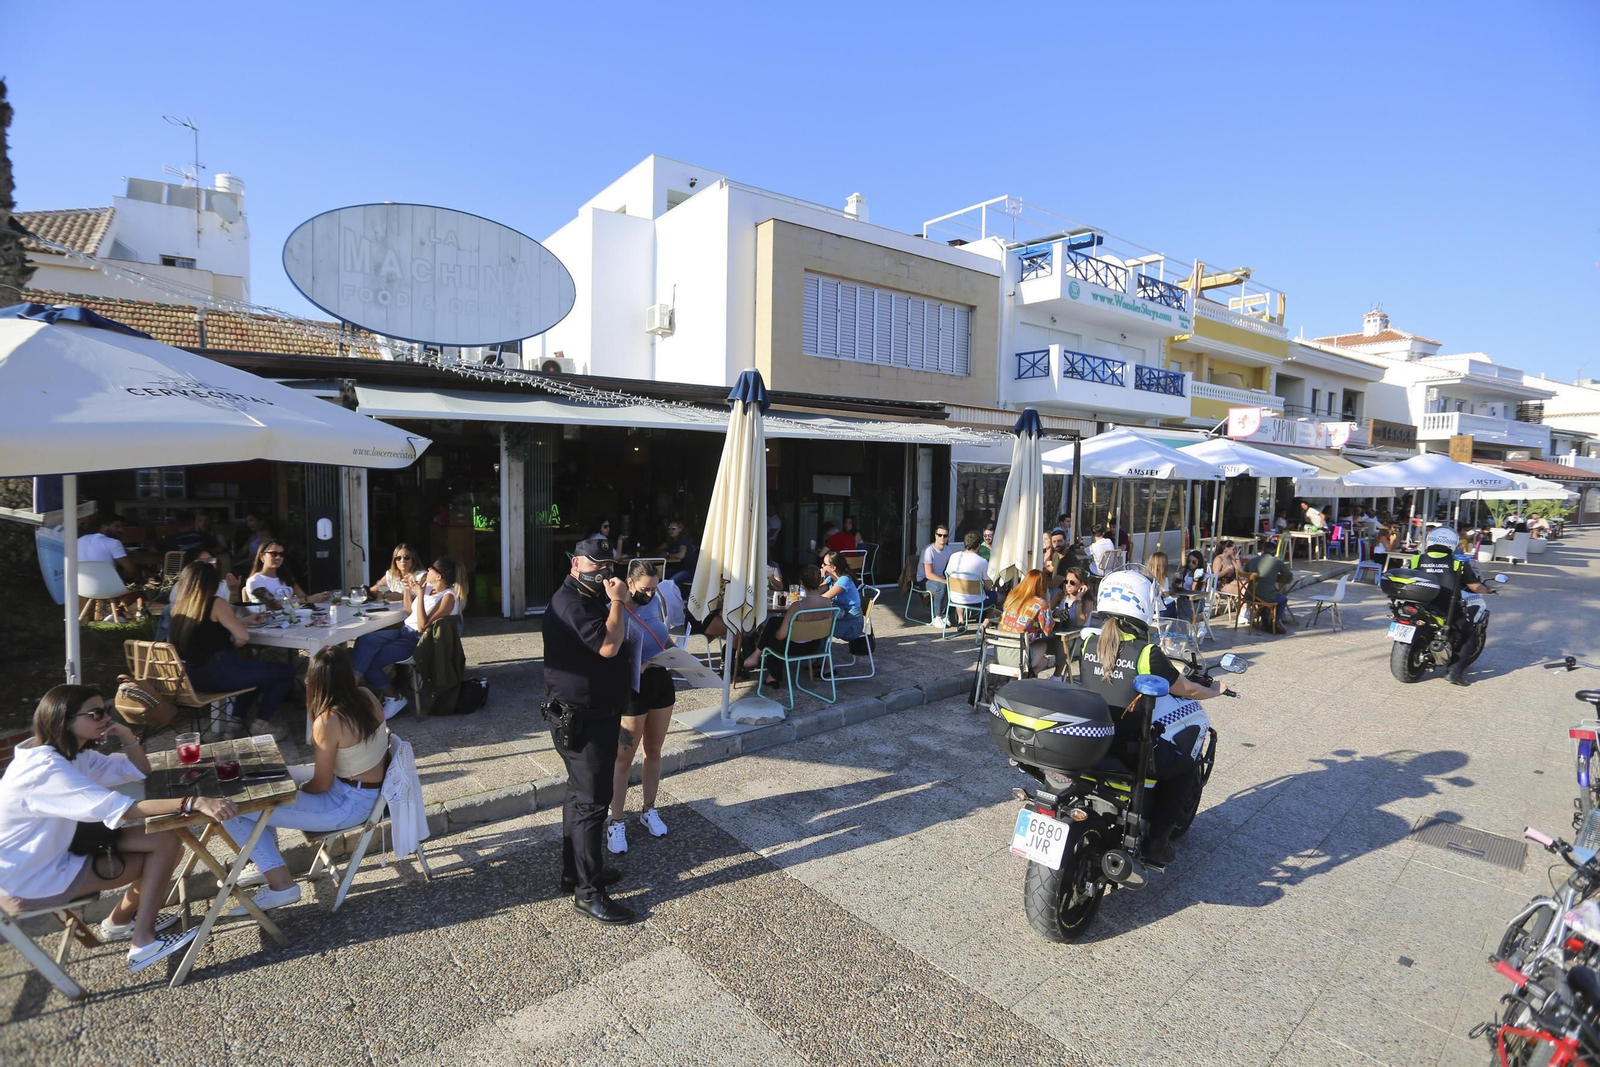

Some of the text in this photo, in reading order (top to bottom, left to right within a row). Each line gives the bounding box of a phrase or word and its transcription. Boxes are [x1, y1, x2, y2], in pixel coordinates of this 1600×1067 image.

[428, 226, 459, 247] LA
[343, 226, 530, 295] MACHINA
[341, 283, 410, 308] FOOD
[422, 295, 437, 312] &
[126, 387, 275, 406] CERVECISTAS
[1469, 478, 1503, 486] AMSTEL
[1030, 819, 1062, 841] 6680
[1026, 835, 1050, 854] JVR
